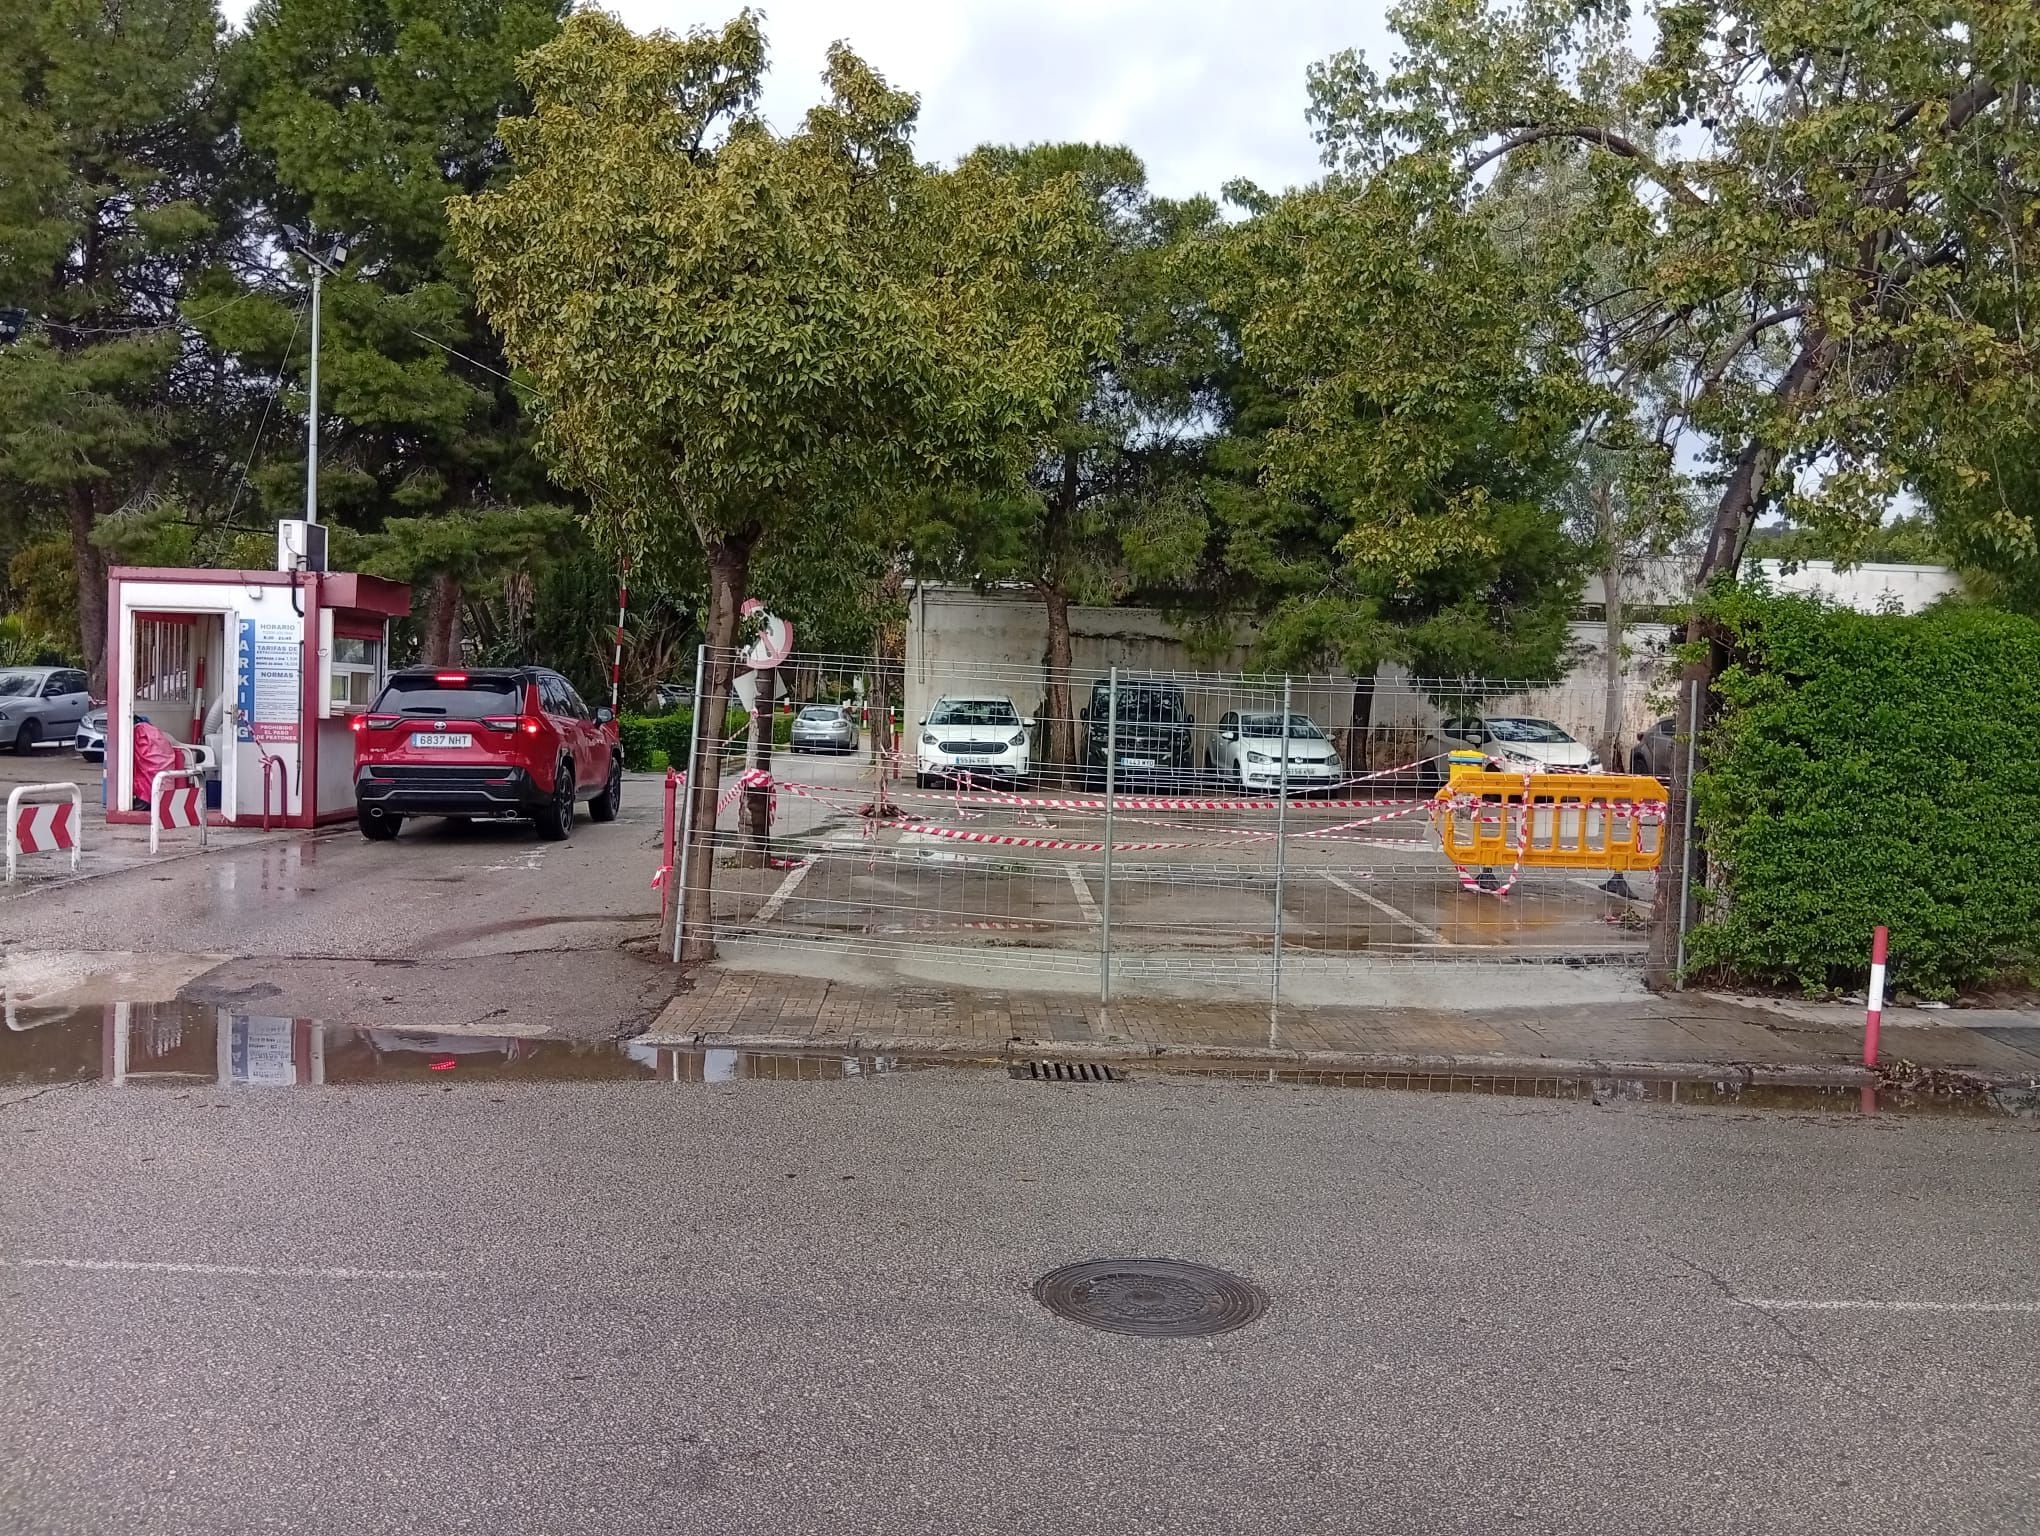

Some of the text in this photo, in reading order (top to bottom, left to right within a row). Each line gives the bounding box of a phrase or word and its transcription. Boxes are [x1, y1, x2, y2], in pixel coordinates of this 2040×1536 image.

[260, 623, 296, 631] HORARIO
[420, 735, 468, 745] 6837 NHT
